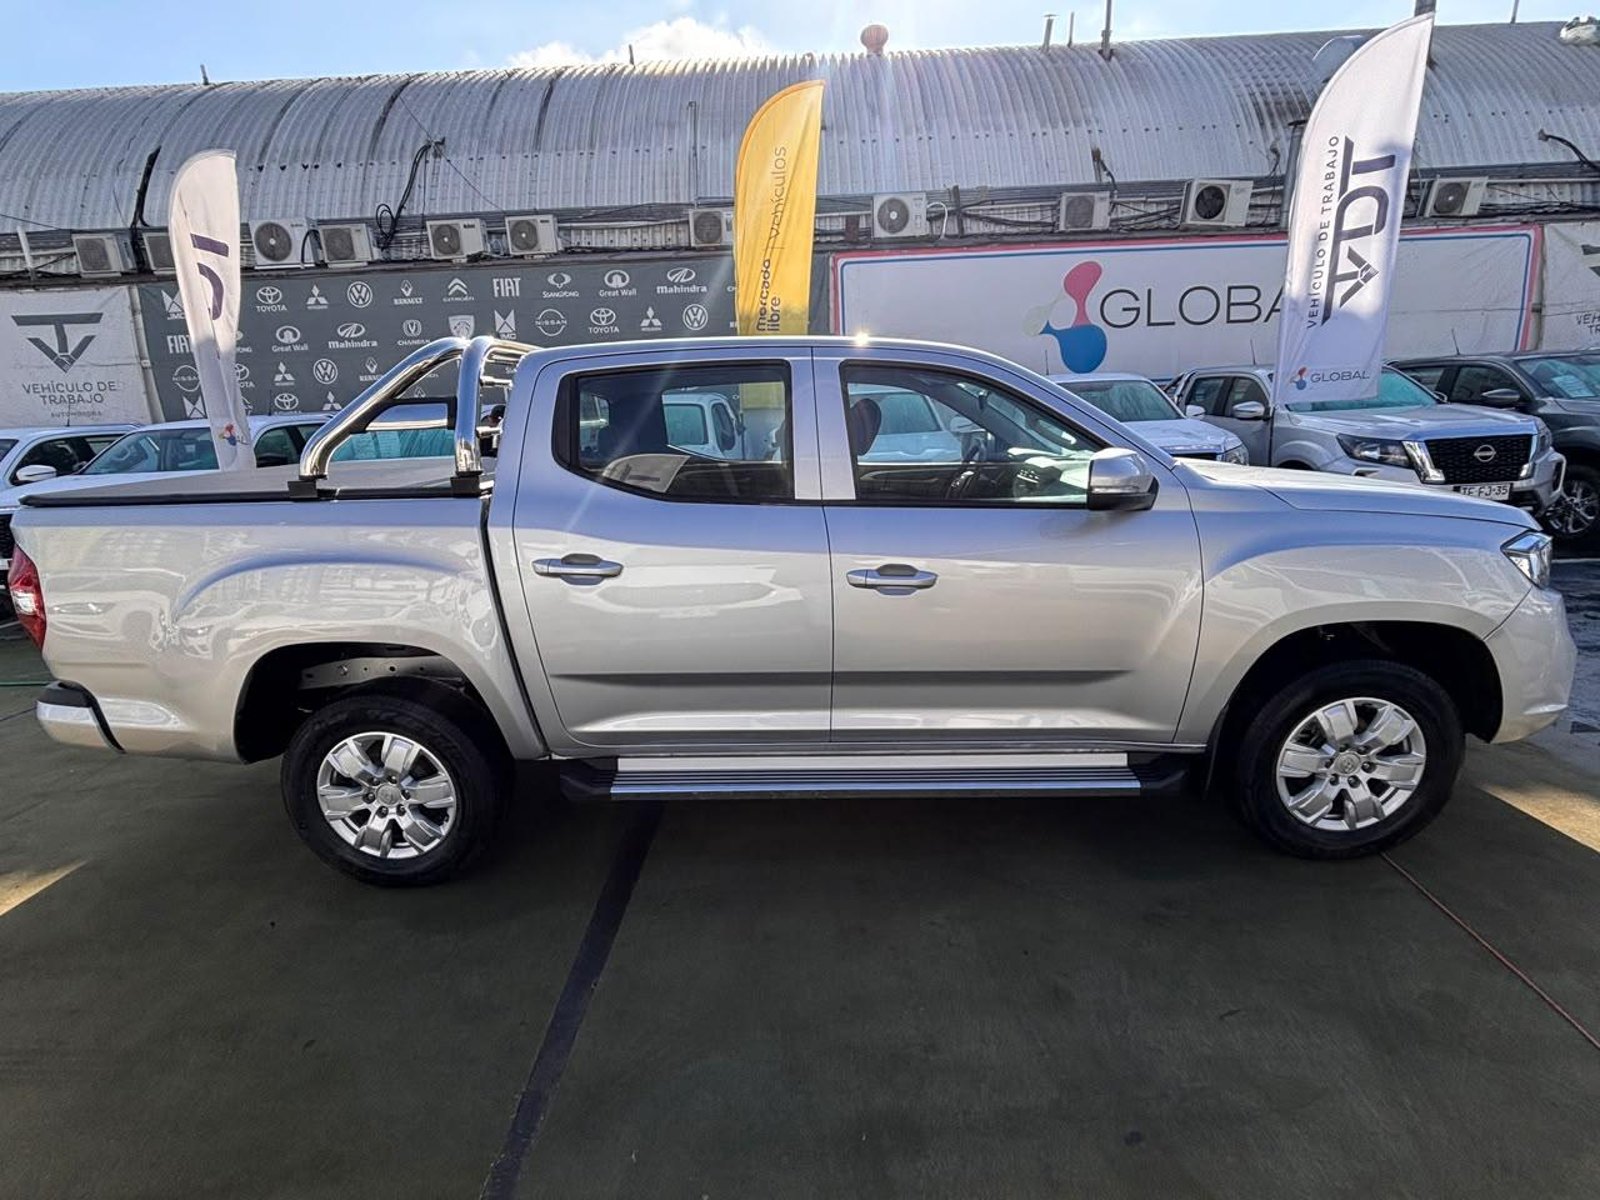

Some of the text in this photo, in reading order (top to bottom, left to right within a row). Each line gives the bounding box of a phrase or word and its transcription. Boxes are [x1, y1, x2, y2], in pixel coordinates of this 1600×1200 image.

[1321, 136, 1339, 215] TRABAJO
[1319, 220, 1330, 241] DE
[492, 277, 521, 298] FIAT
[599, 288, 637, 298] Great Wall
[656, 284, 708, 294] Mahindra
[256, 304, 287, 313] TOYOTA
[1100, 285, 1284, 328] GLOBA
[767, 296, 781, 332] libre
[588, 326, 620, 334] TOYOTA
[166, 334, 190, 354] FIA
[328, 340, 378, 349] Mahindra
[1310, 370, 1370, 383] GLOBAL
[22, 380, 117, 395] VEHÍCULO DE
[40, 393, 104, 406] TRABAJO
